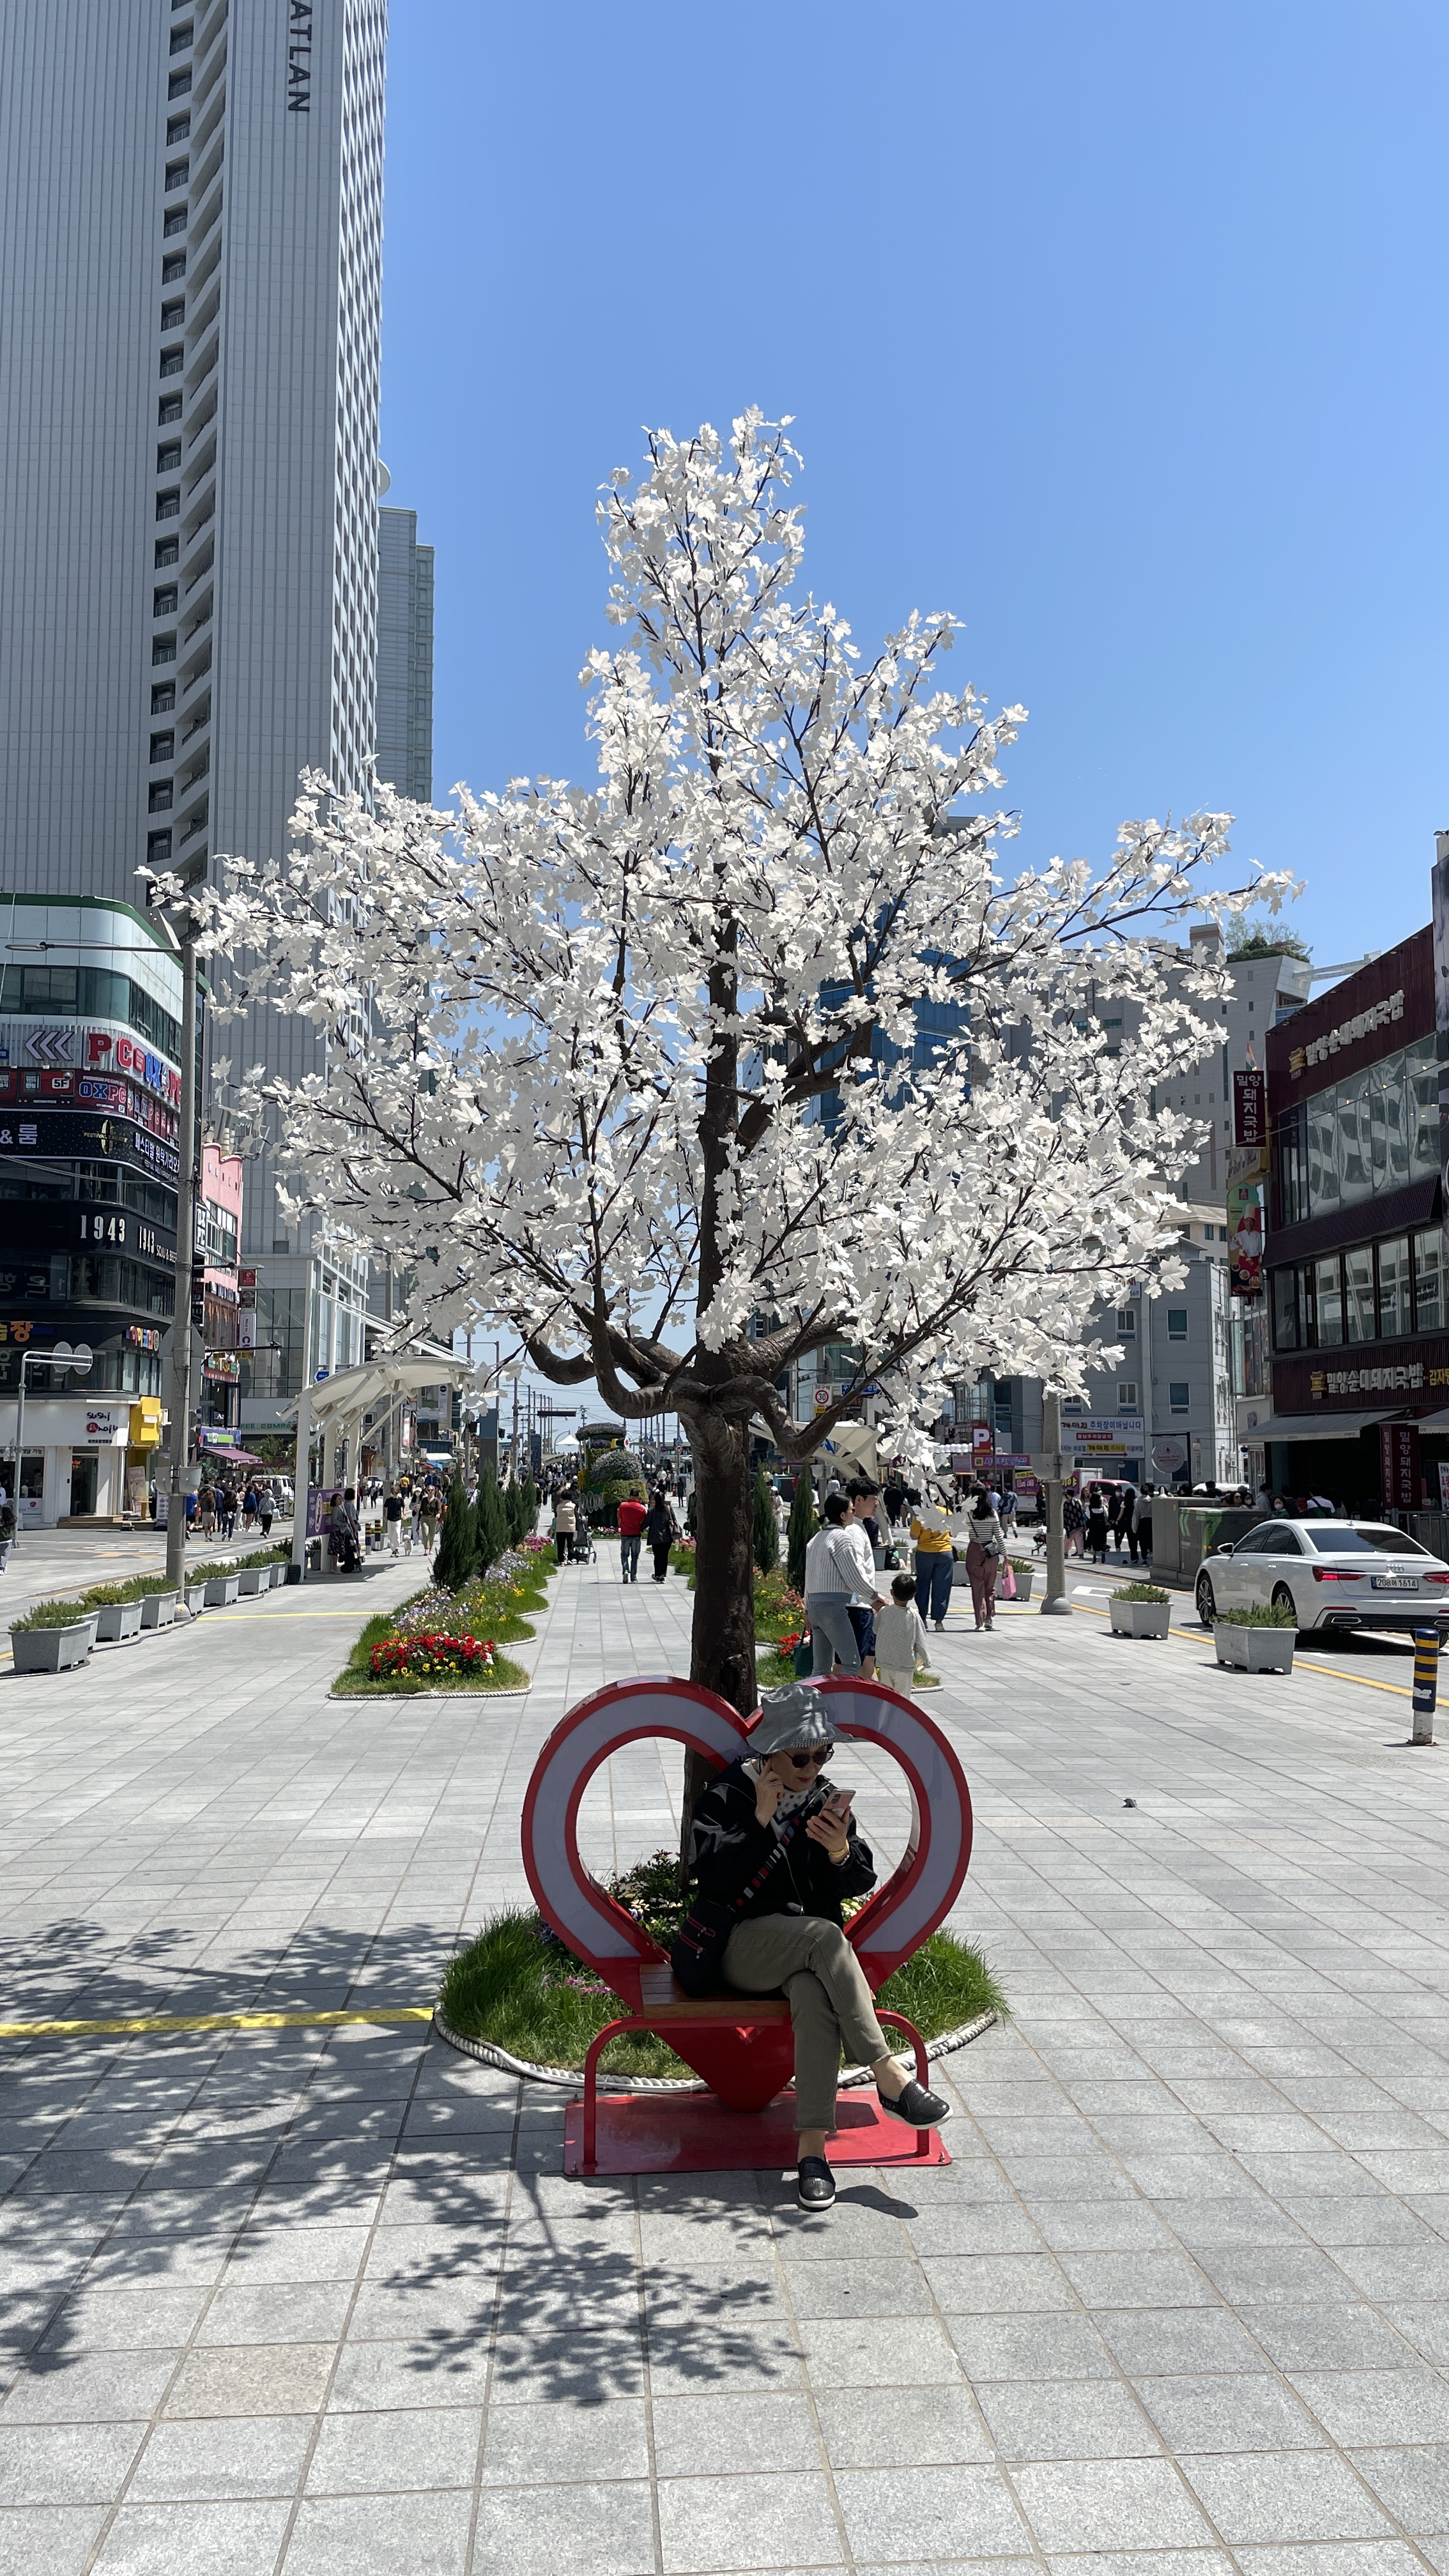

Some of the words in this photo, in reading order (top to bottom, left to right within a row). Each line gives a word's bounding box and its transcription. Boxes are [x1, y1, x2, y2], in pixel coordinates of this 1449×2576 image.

[288, 0, 312, 112] ATLAN
[88, 1033, 132, 1068] PC
[79, 1081, 126, 1104] OXPC
[1236, 1075, 1262, 1087] 밀양
[1242, 1088, 1258, 1143] 돼지국밥
[18, 1124, 38, 1145] 룸
[156, 1144, 180, 1174] 원탁가라오
[80, 1215, 126, 1243] 1943
[138, 1225, 155, 1254] 1943
[1327, 1362, 1424, 1394] 밀양순대돼지국밥
[973, 1428, 990, 1448] P
[1399, 1431, 1412, 1503] 밀양돼지국밥
